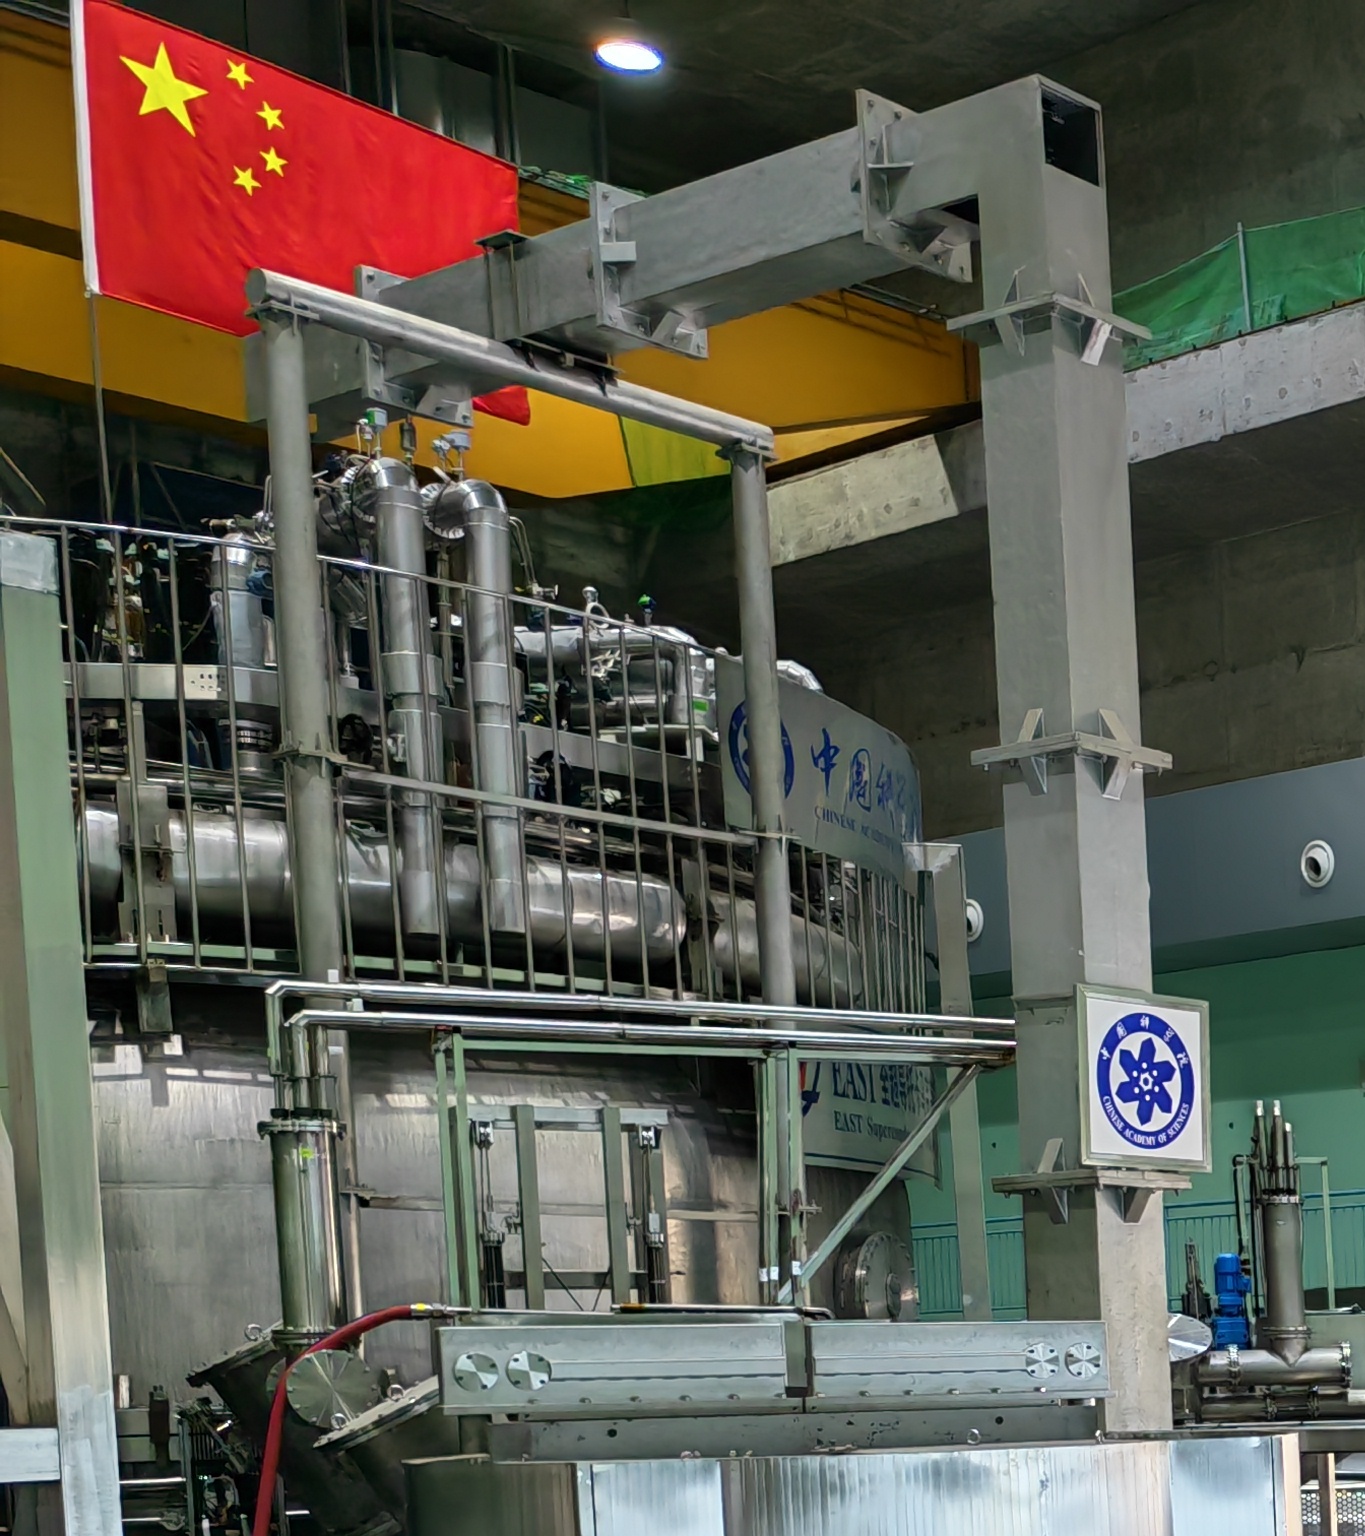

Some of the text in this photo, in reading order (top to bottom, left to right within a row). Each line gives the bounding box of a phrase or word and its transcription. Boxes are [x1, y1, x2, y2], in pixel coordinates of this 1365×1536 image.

[832, 1061, 876, 1103] EAST
[834, 1110, 862, 1134] EAST
[1102, 1096, 1190, 1146] CHINESE ACADEMY OF SCIENCES
